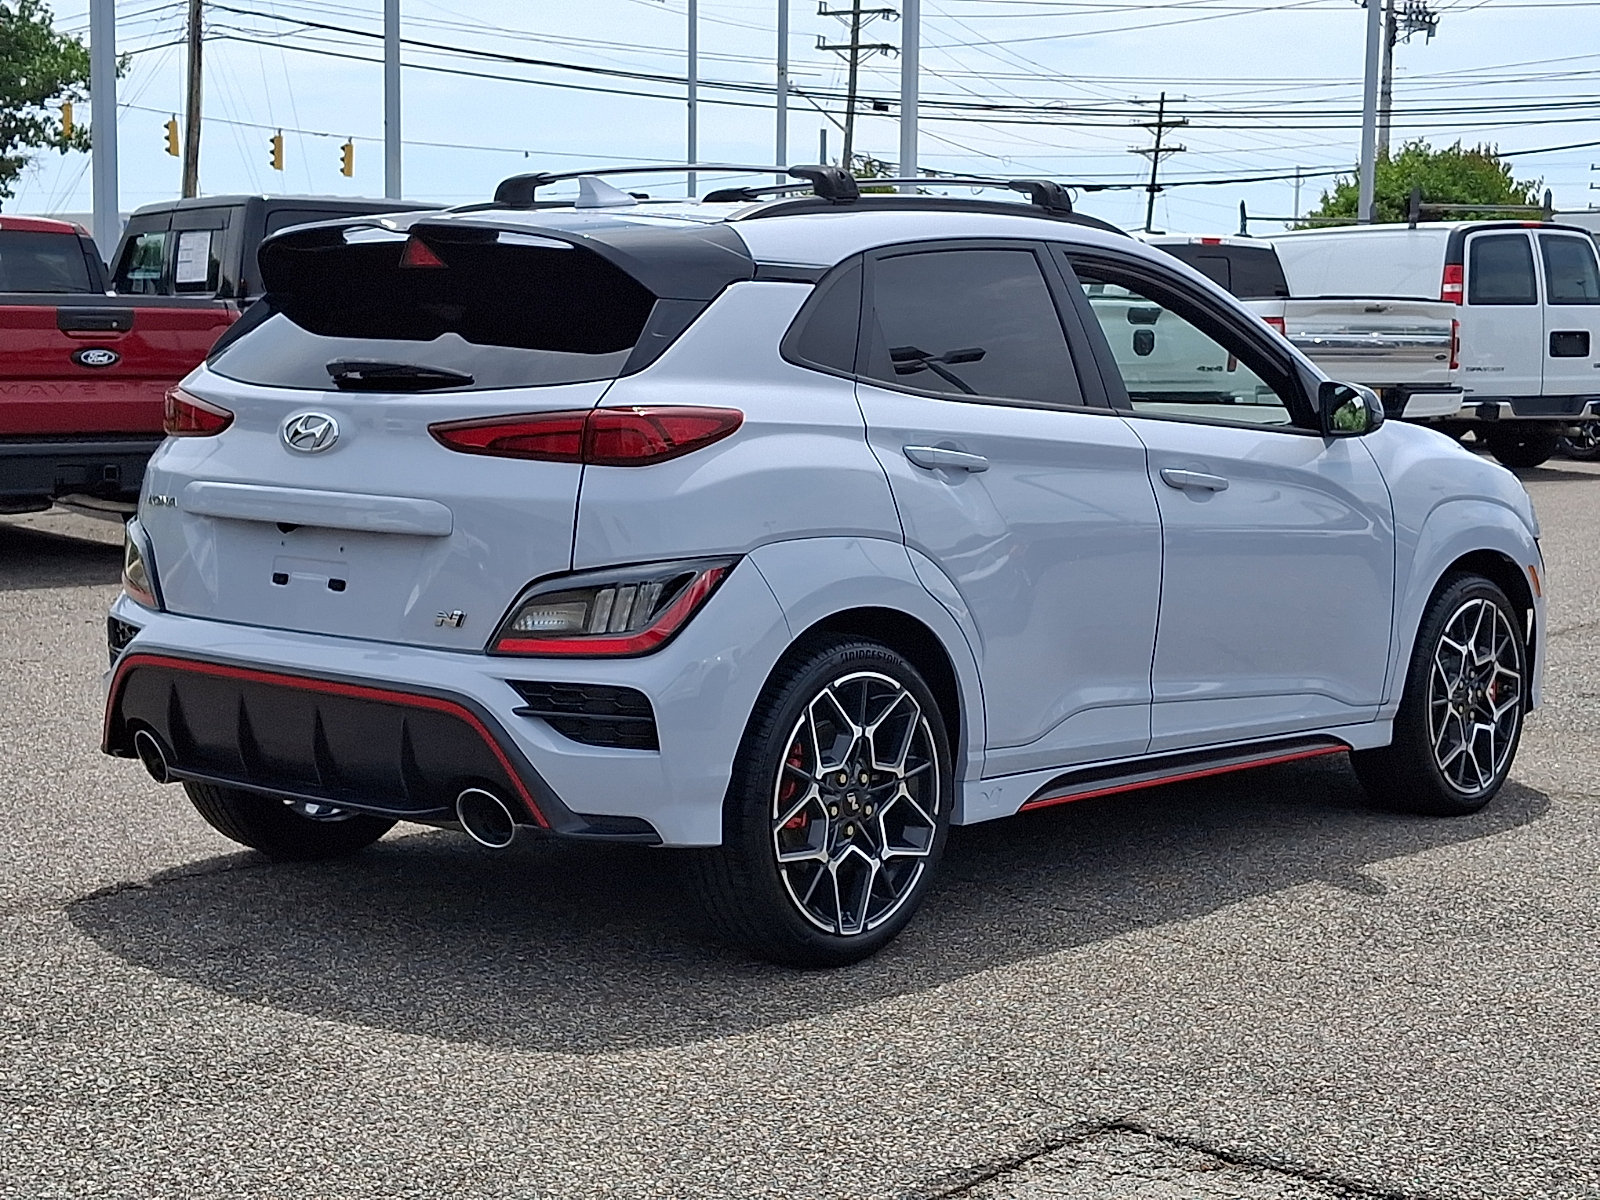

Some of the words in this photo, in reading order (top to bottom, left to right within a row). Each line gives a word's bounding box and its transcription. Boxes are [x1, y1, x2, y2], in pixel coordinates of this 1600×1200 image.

[0, 384, 166, 396] MAVERIC
[149, 494, 178, 507] KONA
[840, 649, 903, 664] BRIDGESTONE
